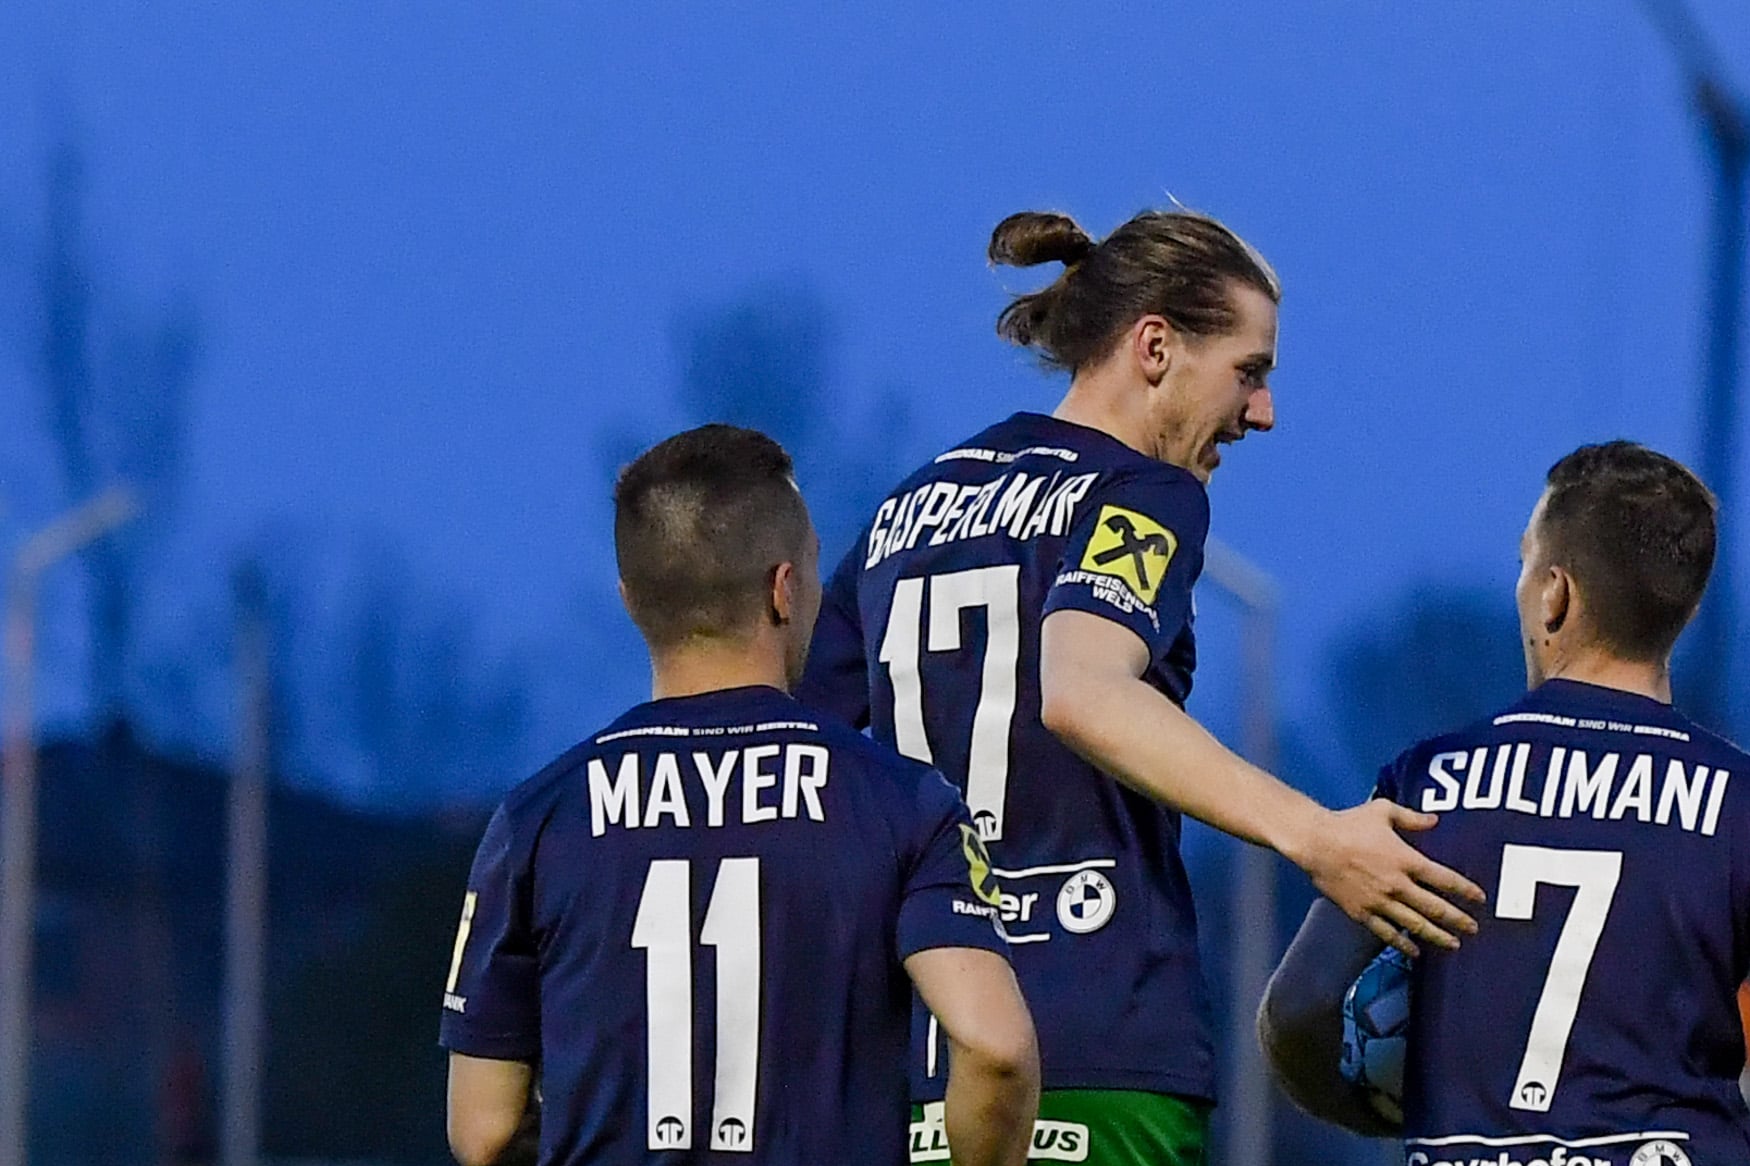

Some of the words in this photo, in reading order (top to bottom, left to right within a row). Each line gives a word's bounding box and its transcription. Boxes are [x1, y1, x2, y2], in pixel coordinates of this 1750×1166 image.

[1092, 586, 1133, 613] WELS
[588, 744, 829, 838] MAYER
[879, 564, 1021, 841] 17
[1422, 743, 1730, 836] SULIMANI
[631, 857, 760, 1152] 11
[1496, 843, 1624, 1112] 7
